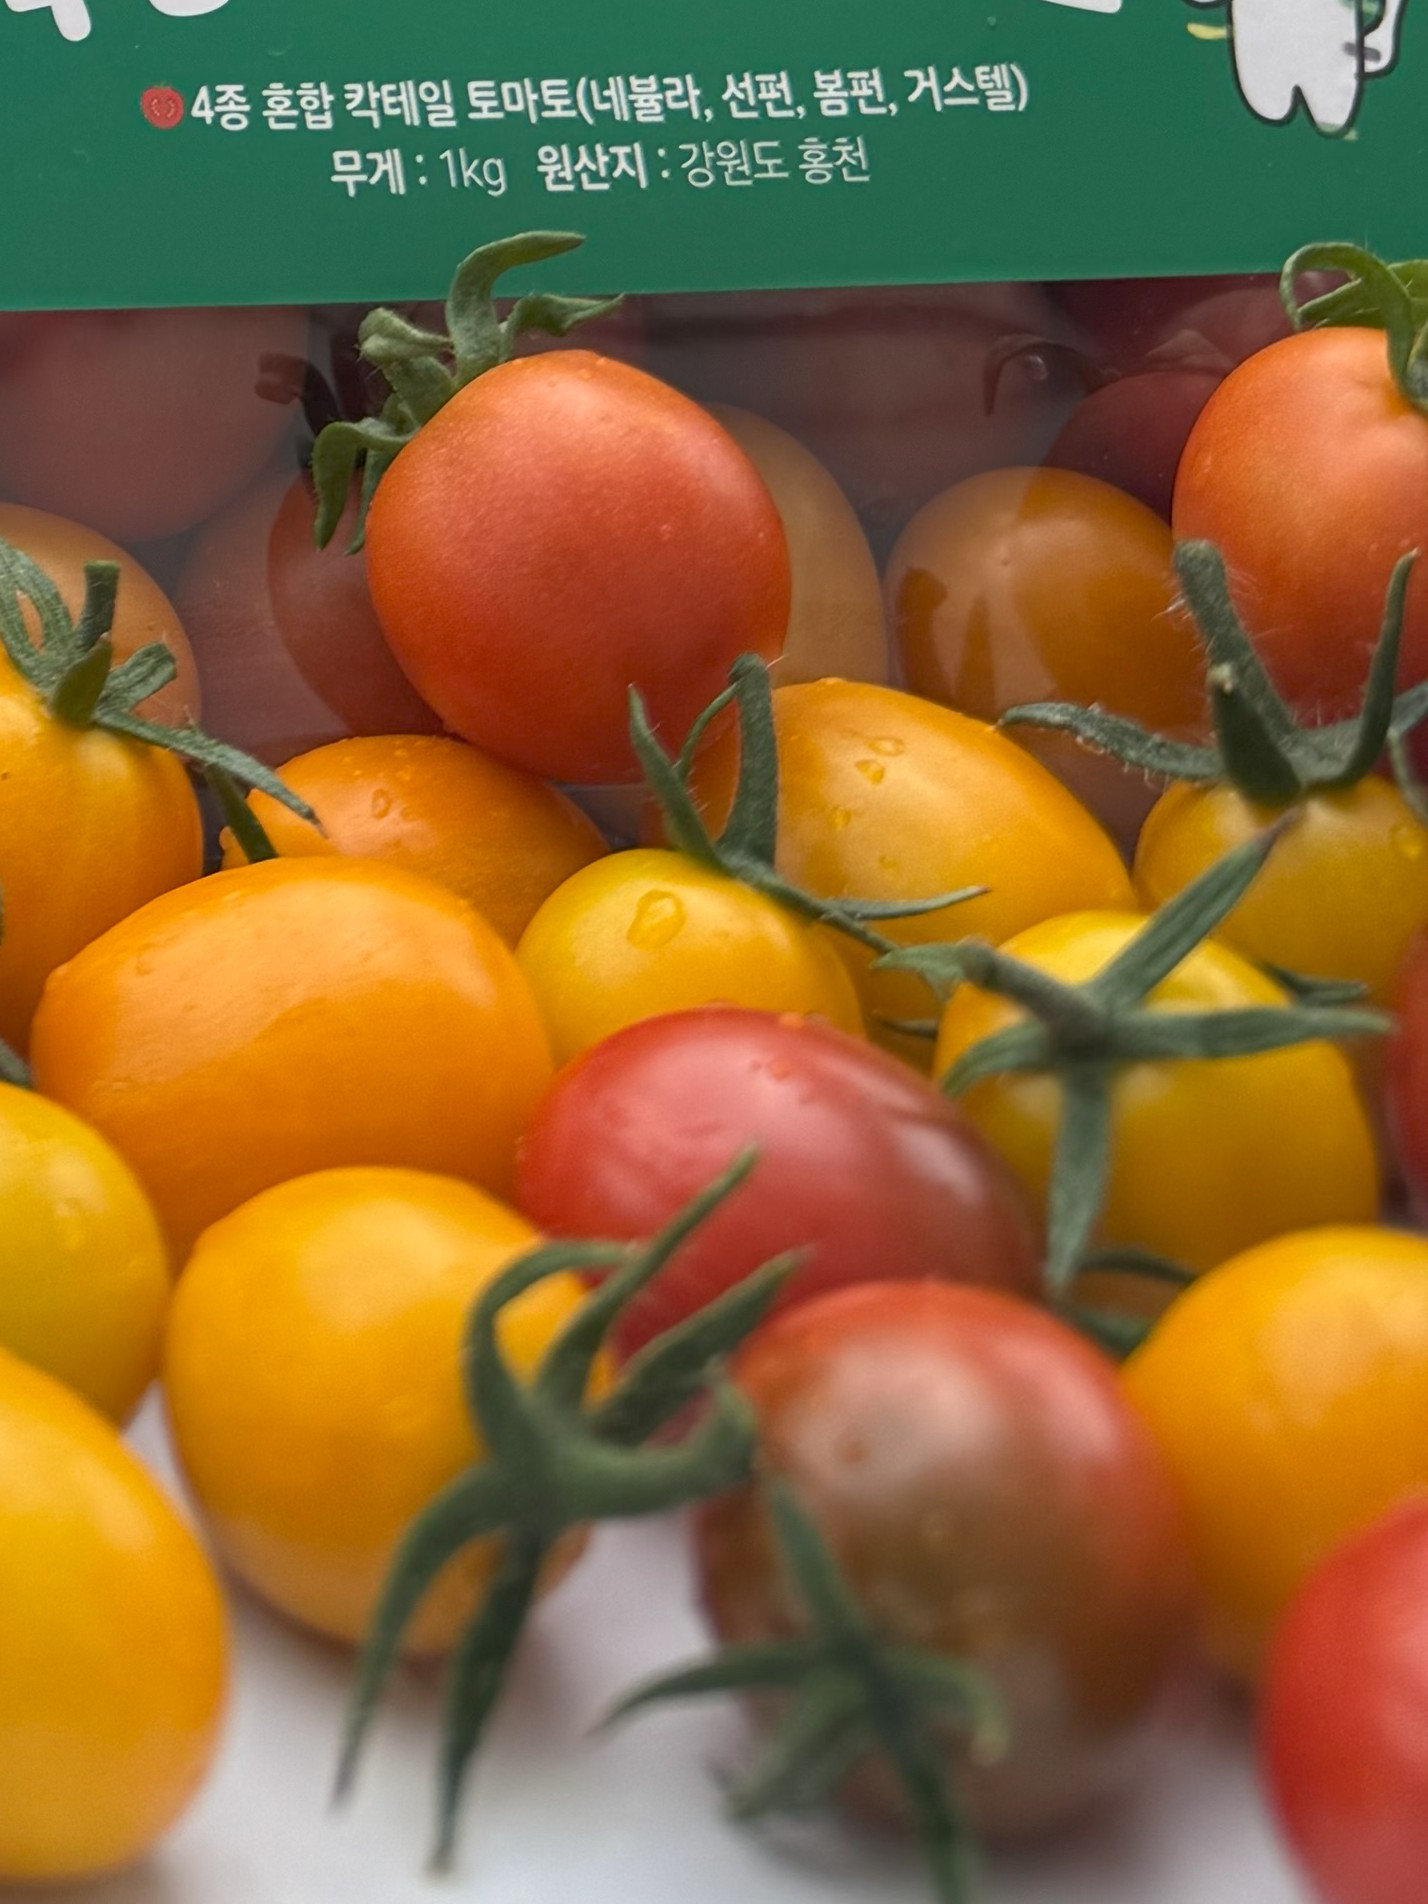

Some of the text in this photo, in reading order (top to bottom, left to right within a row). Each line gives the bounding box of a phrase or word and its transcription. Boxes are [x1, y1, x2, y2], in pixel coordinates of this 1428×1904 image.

[191, 85, 250, 130] 4종
[263, 83, 334, 129] 혼합
[344, 80, 456, 128] 칵테일
[722, 71, 805, 118] 선펀,
[814, 69, 897, 116] 봄펀,
[904, 64, 1027, 111] 거스텔)
[331, 149, 405, 197] 무게
[440, 148, 506, 196] 1kg
[538, 143, 647, 191] 원산지
[679, 140, 788, 187] 강원도
[798, 137, 869, 184] 홍천
